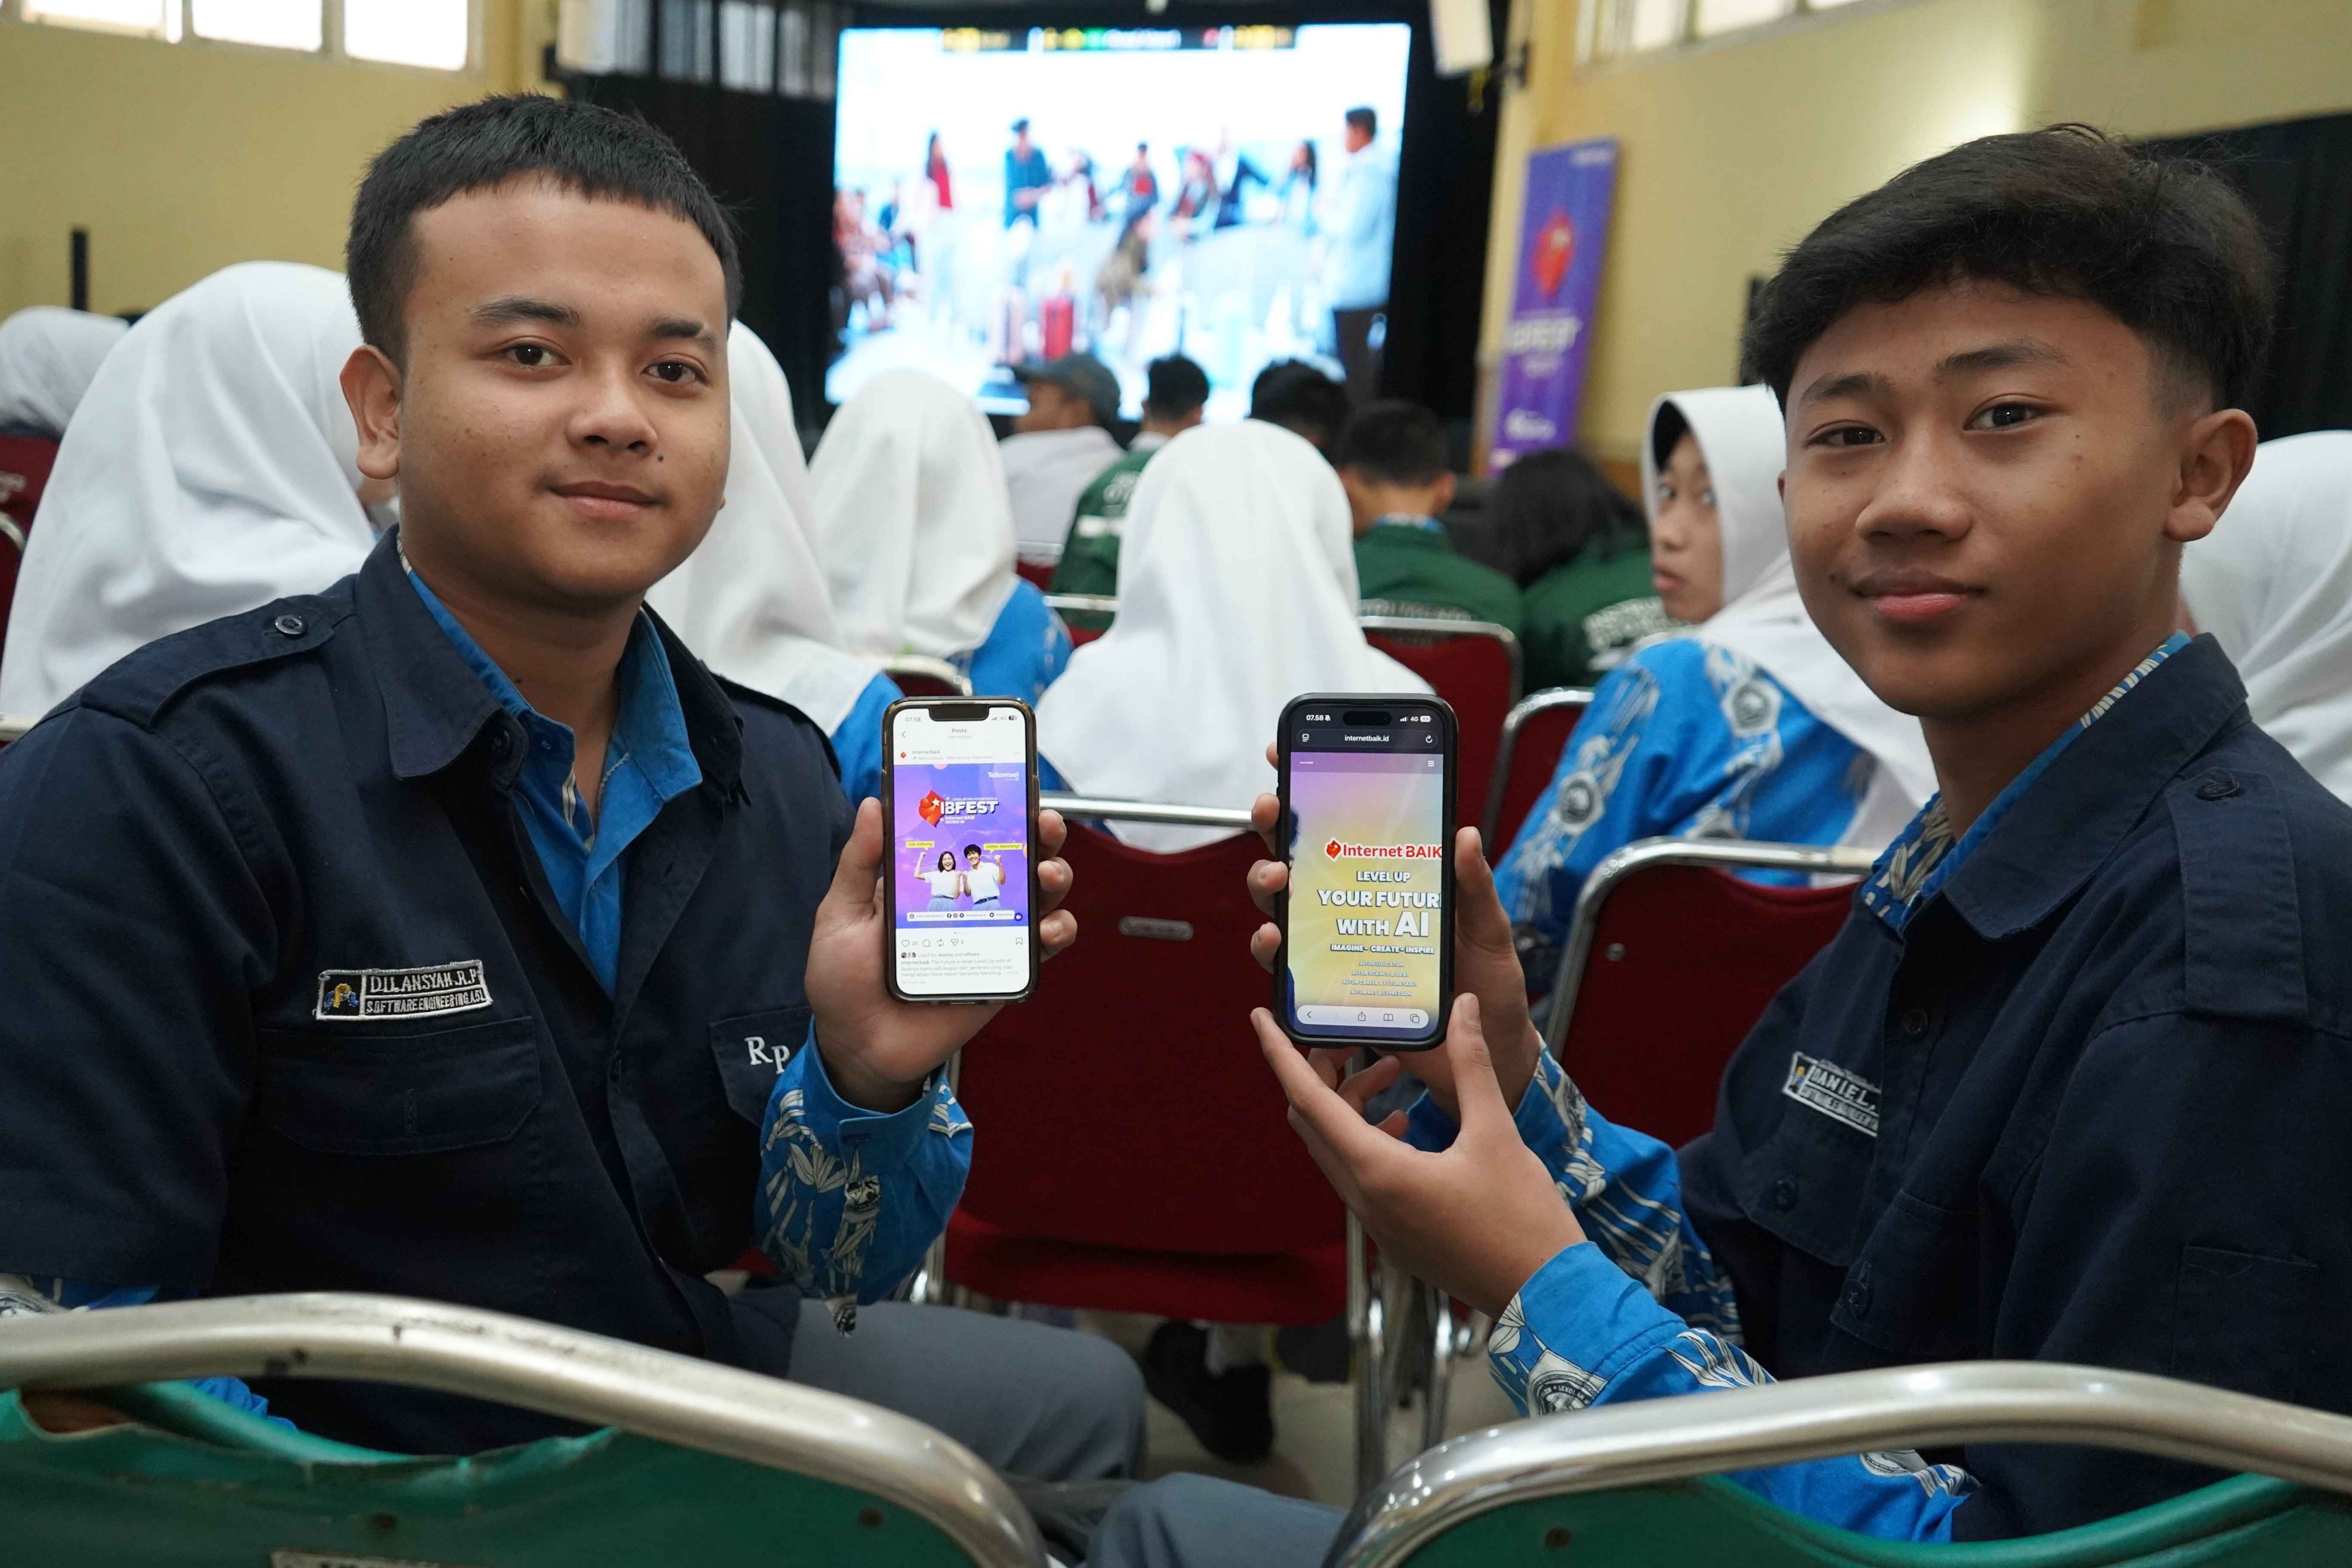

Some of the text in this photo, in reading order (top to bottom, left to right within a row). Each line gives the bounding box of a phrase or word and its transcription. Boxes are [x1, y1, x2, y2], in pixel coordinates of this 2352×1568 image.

[940, 801, 999, 815] IBFEST
[1343, 844, 1442, 858] Internet BAIK
[1357, 871, 1411, 882] LEVEL UP
[1317, 890, 1441, 909] YOUR FUTUR
[1336, 911, 1429, 937] WITH AI
